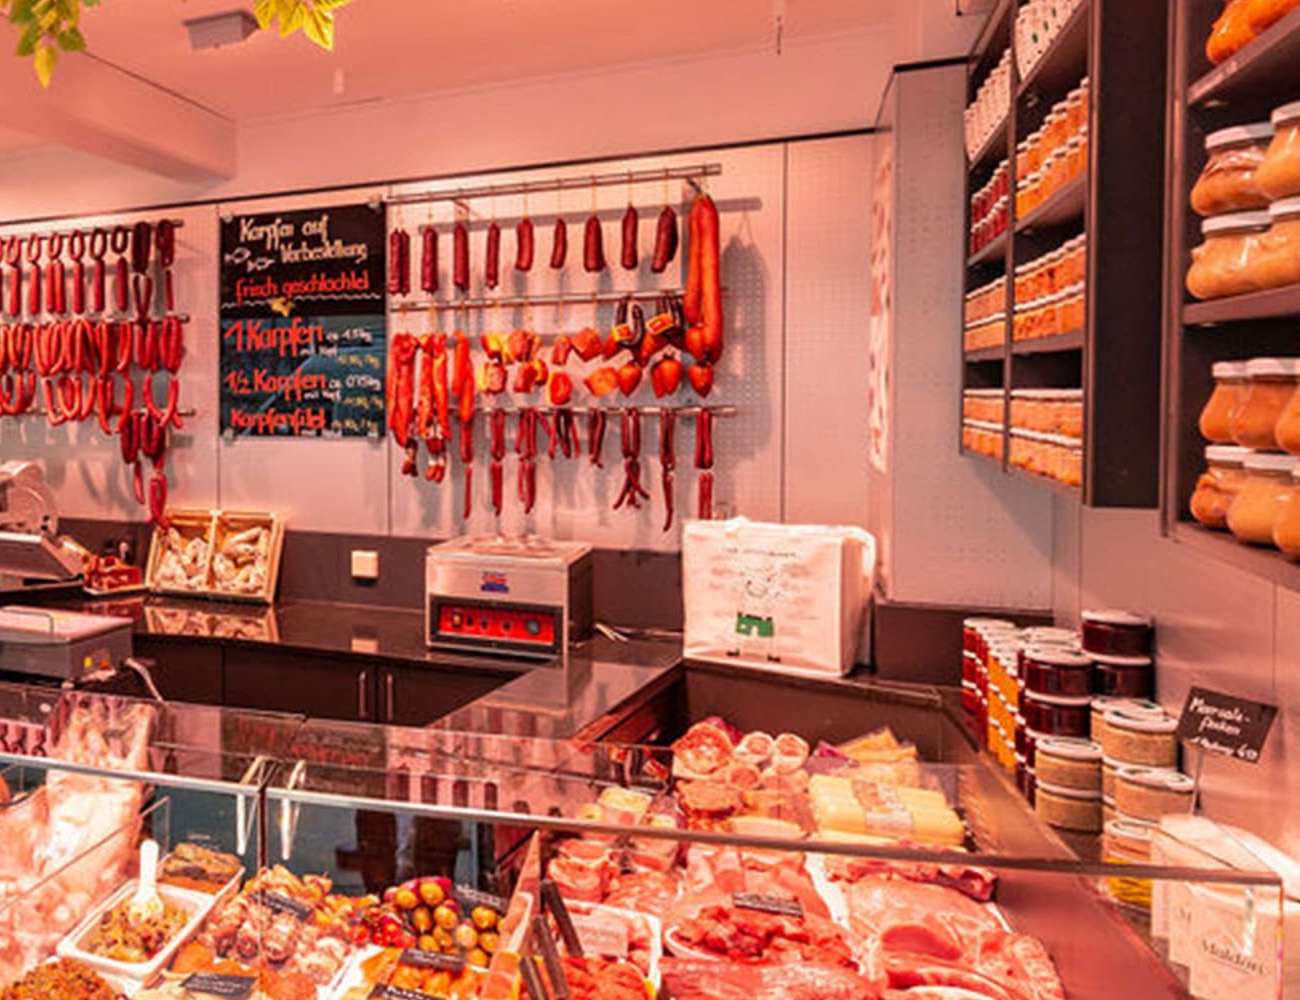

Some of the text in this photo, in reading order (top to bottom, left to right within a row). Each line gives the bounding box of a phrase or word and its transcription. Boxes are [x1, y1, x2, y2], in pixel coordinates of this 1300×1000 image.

[240, 214, 328, 250] Karpfen auf
[280, 240, 368, 264] Vorbestellung
[236, 269, 370, 307] frisch geschlachtet
[223, 320, 243, 352] 1
[246, 316, 324, 358] Karpfen
[253, 367, 327, 401] Karpfen
[230, 407, 326, 435] Karpfenfilet
